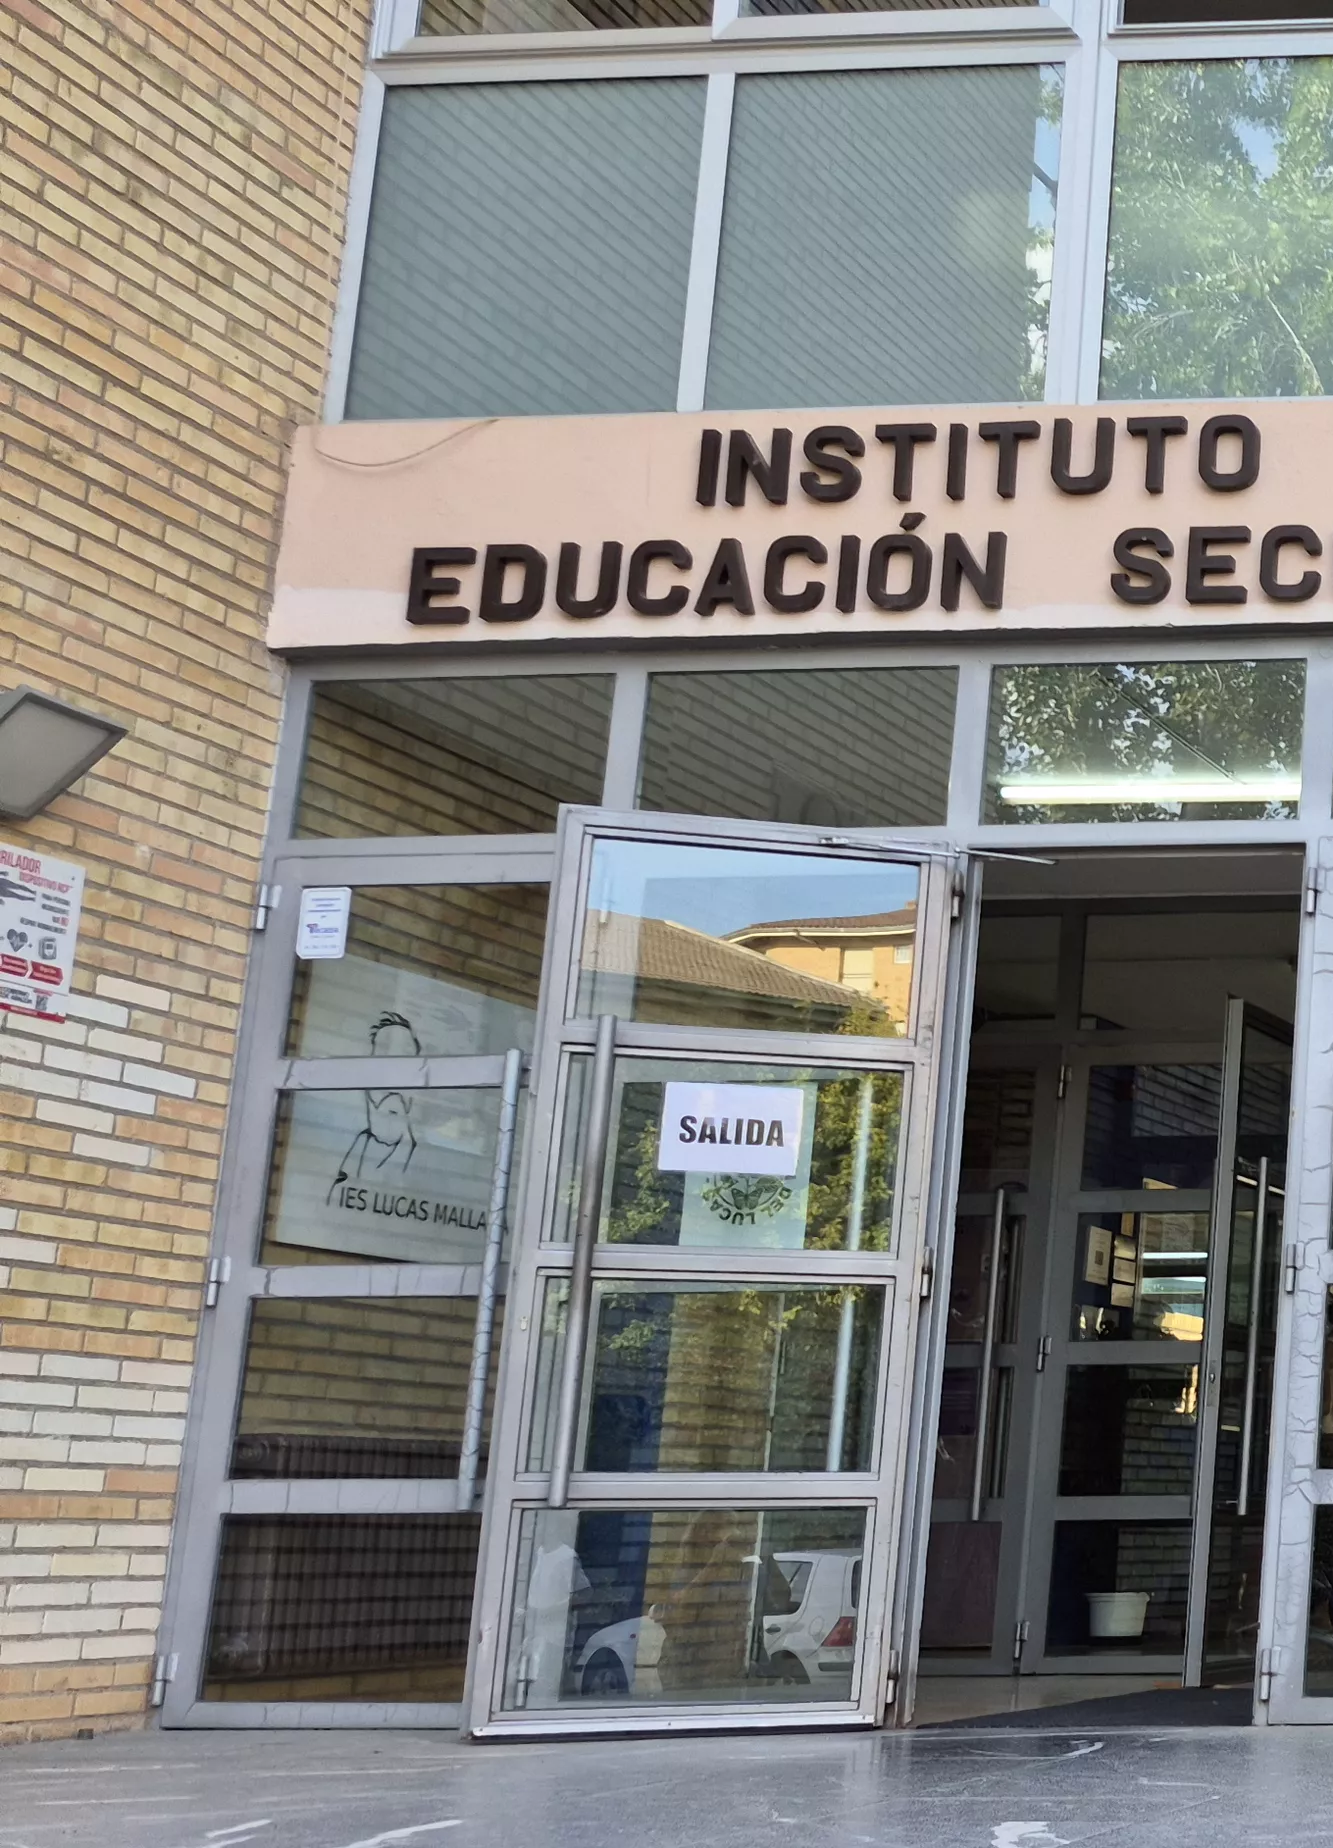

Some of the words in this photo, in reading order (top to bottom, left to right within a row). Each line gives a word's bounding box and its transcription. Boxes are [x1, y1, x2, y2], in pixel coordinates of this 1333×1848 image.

[695, 415, 1261, 507] INSTITUTO
[405, 512, 1007, 625] EDUCACIÓN
[678, 1115, 785, 1148] SALIDA
[339, 1187, 368, 1211] IES
[372, 1192, 429, 1222] LUCAS
[433, 1203, 509, 1236] MALLA
